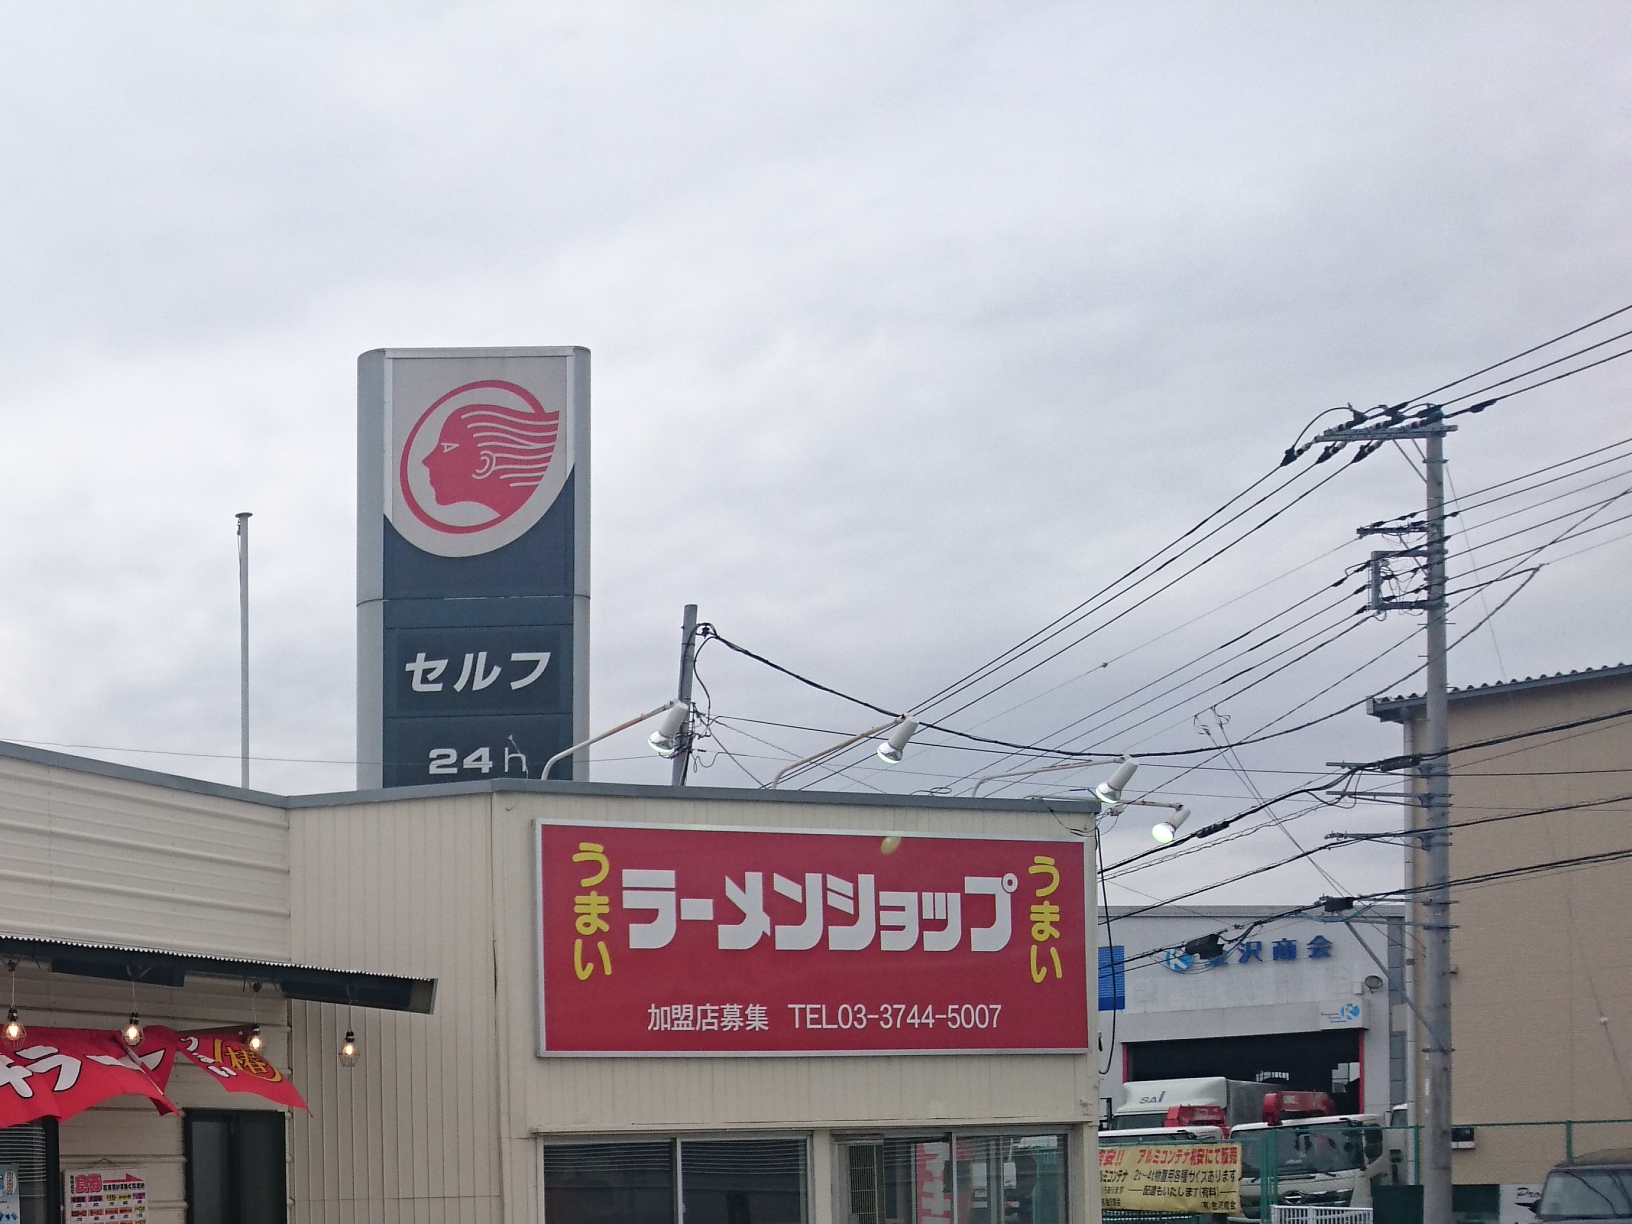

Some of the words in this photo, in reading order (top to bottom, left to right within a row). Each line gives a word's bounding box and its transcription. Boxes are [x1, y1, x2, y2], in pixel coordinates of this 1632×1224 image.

[404, 650, 552, 693] セルフ
[571, 842, 613, 981] うまい
[621, 868, 1019, 953] ラーメンショップ
[1028, 855, 1063, 985] うまい
[646, 1003, 770, 1033] 加盟店募集
[787, 1002, 1002, 1031] TEL03-3744-5007
